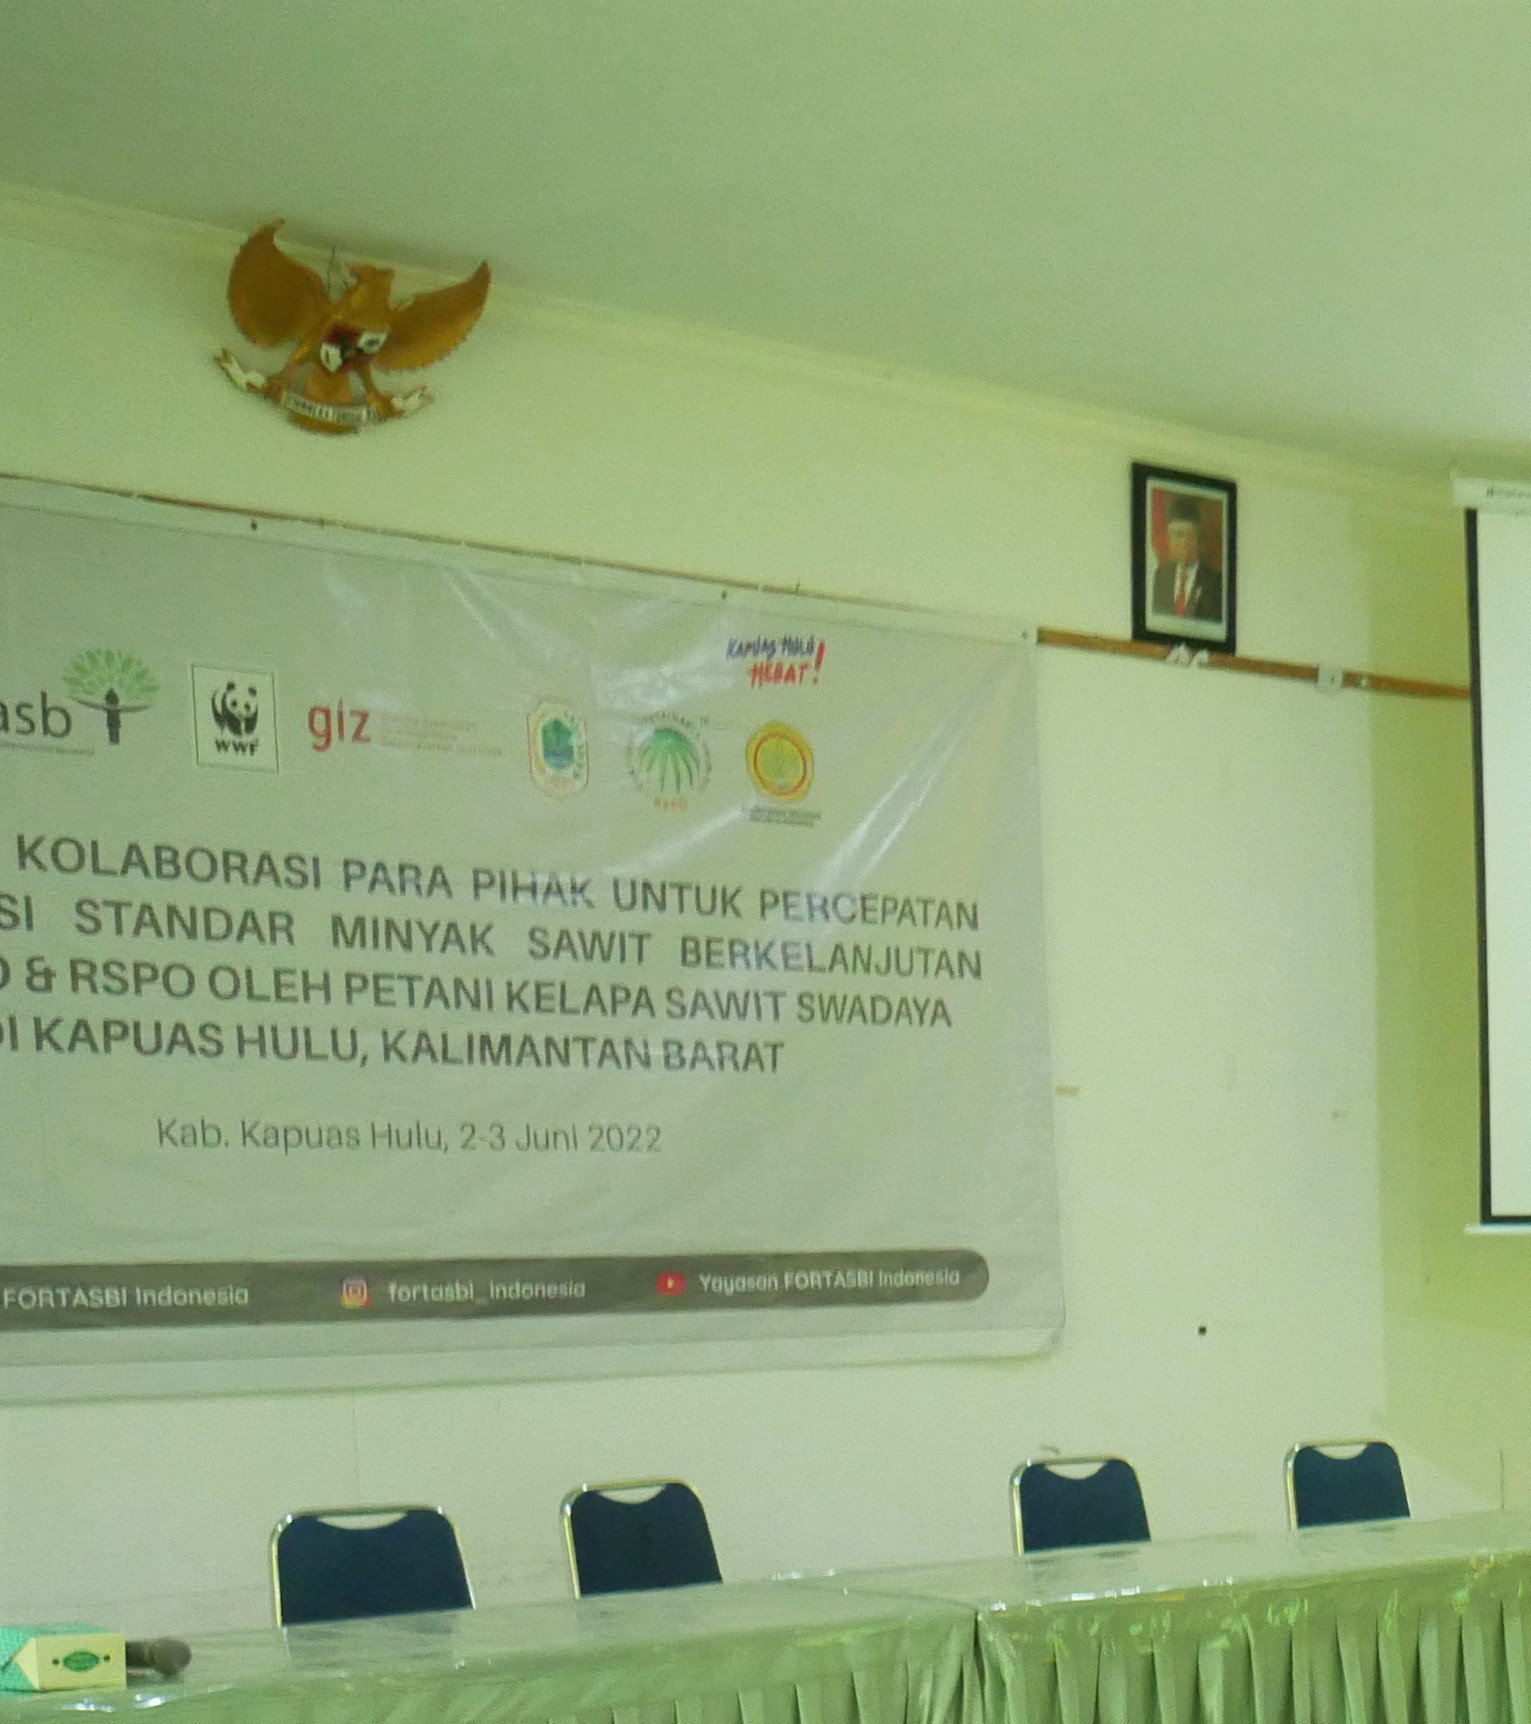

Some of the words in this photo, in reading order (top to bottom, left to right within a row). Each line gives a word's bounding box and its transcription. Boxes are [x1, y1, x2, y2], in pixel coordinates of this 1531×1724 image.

[215, 737, 259, 756] WWF
[308, 696, 371, 752] giz
[16, 833, 321, 890] KOLABORASI
[343, 857, 454, 901] PARA
[472, 867, 595, 910] PIHAK
[612, 877, 744, 919] UNTUK
[759, 887, 979, 932] PERCEPATAN
[75, 897, 296, 946] STANDAR
[330, 914, 497, 956] MINYAK
[527, 926, 652, 966] SAWIT
[680, 935, 982, 981] BERKELANJUTAN
[26, 955, 56, 994] &
[69, 957, 196, 998] RSPO
[208, 964, 332, 1006] OLEH
[345, 971, 494, 1012] PETANI
[505, 979, 657, 1020] KELAPA
[666, 985, 787, 1023] SAWIT
[797, 991, 953, 1029] SWADAYA
[33, 1015, 225, 1058] KAPUAS
[237, 1023, 369, 1068] HULU,
[381, 1027, 651, 1071] KALIMANTAN
[662, 1038, 785, 1073] BARAT
[157, 1116, 230, 1150] Kab.
[241, 1119, 361, 1156] Kapuas
[371, 1121, 449, 1154] Hulu,
[459, 1122, 506, 1152] 2-3
[515, 1123, 579, 1153] Juni
[588, 1124, 663, 1153] 2022
[3, 1286, 128, 1310] FORTASBI
[135, 1284, 249, 1307] Indonesia
[699, 1272, 779, 1297] Yayasan
[783, 1268, 874, 1291] FORTASBI
[878, 1267, 961, 1288] Indonesia
